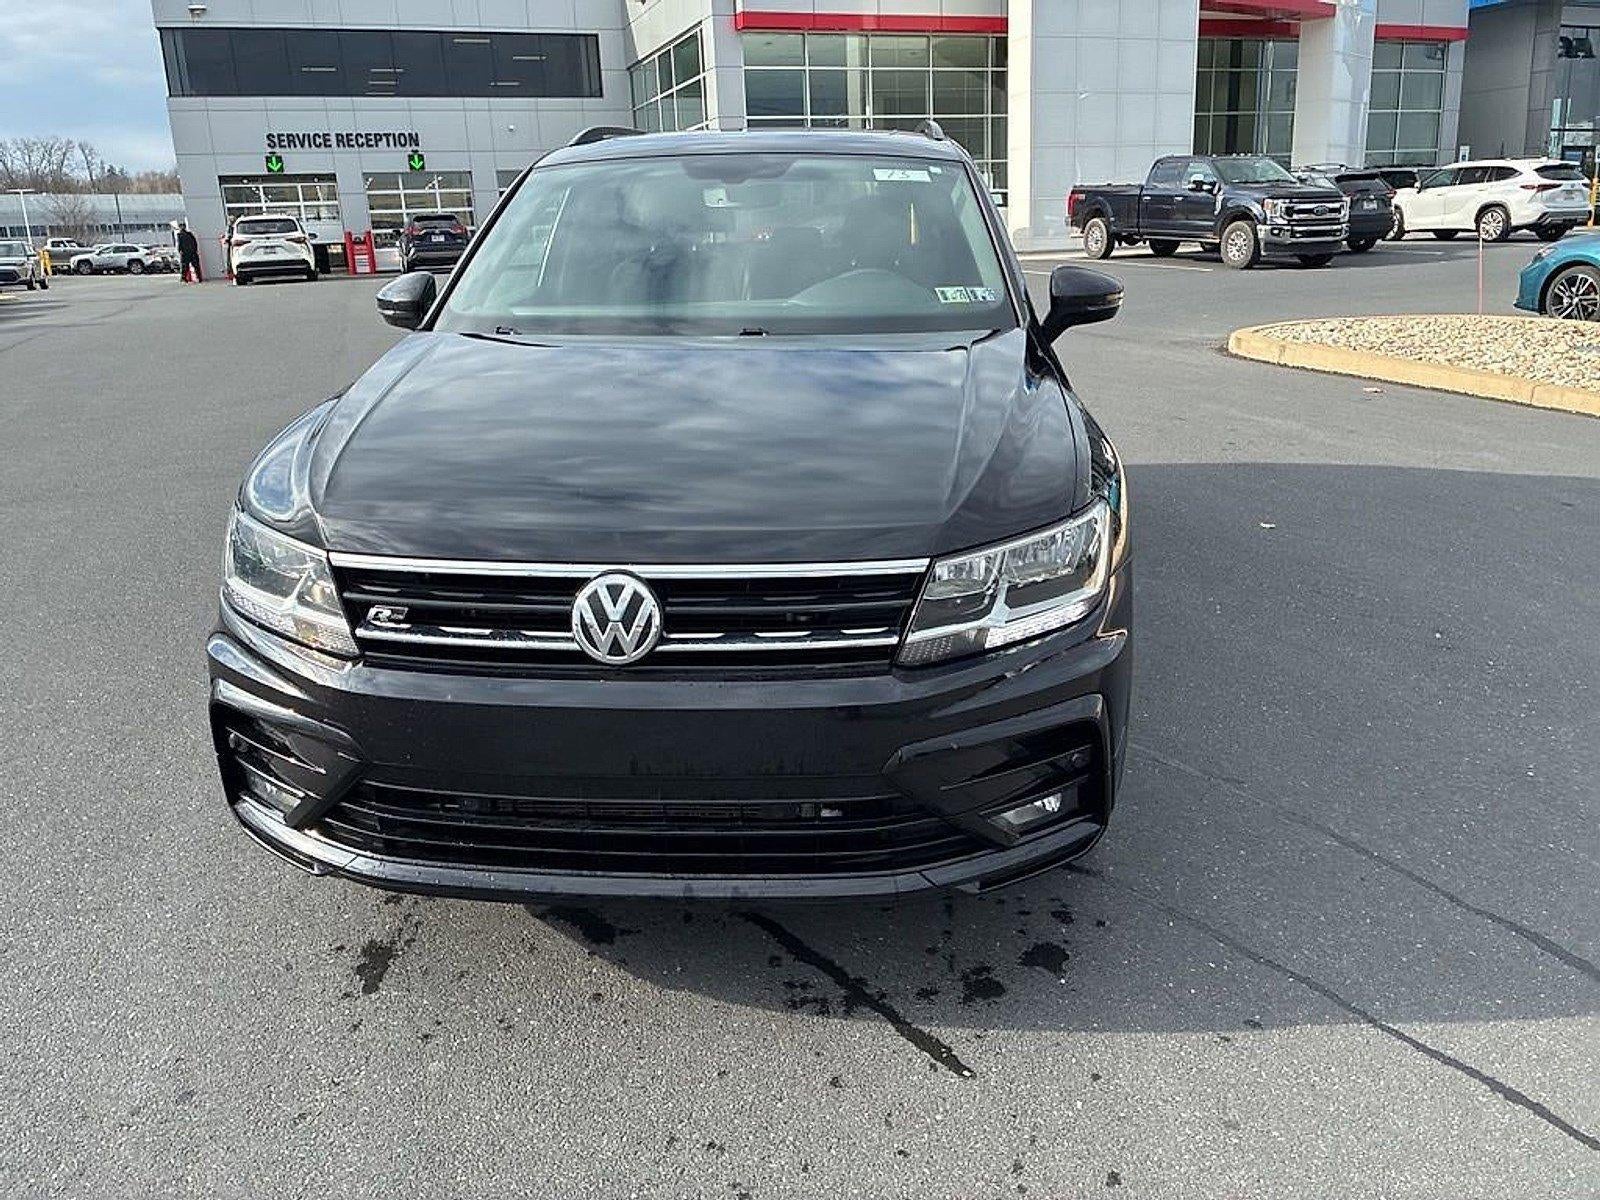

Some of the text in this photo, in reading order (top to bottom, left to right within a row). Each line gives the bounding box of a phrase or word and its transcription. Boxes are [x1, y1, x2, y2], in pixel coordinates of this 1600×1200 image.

[266, 132, 420, 149] SERVICE RECEPTION
[573, 574, 660, 664] VW
